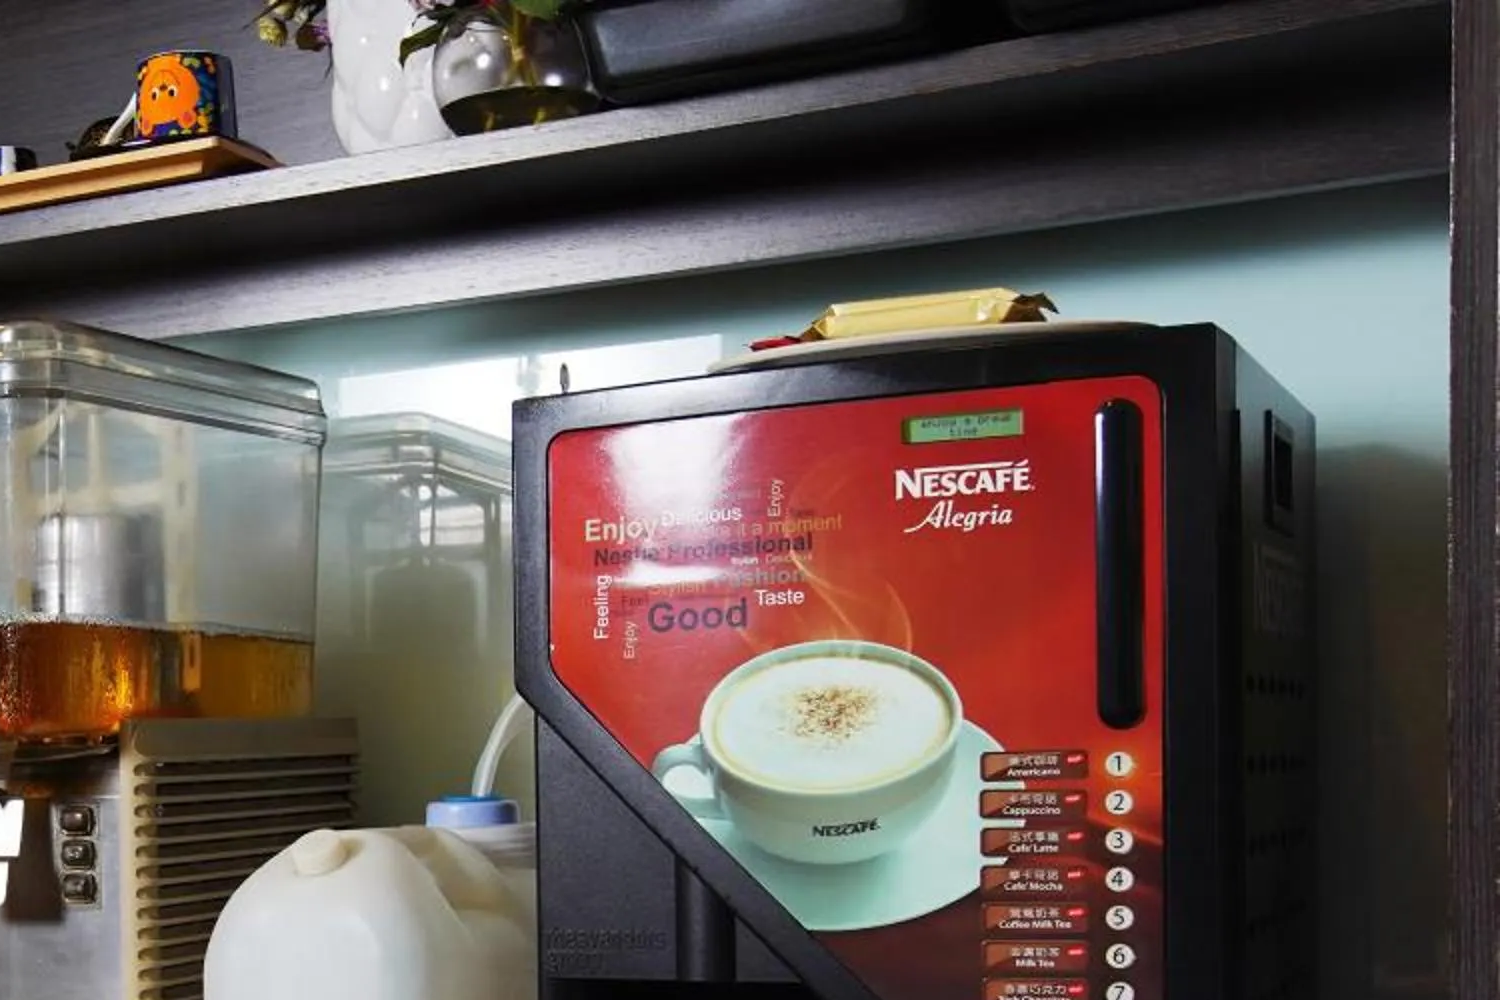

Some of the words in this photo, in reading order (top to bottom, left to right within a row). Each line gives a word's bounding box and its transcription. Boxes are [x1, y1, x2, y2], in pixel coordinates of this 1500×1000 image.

[895, 459, 1031, 500] NESCAFÉ
[768, 479, 785, 518] Enjoy
[584, 515, 660, 545] Enjoy
[769, 514, 843, 534] moment
[904, 500, 1012, 533] Alegria
[594, 575, 613, 640] Feeling
[755, 588, 805, 607] Taste
[648, 598, 748, 633] Good
[624, 620, 640, 659] Enjoy
[1007, 768, 1061, 777] Americano
[1003, 806, 1061, 817] Cappuccino
[1030, 881, 1064, 892] Mocha
[999, 919, 1030, 929] Coffee
[1032, 919, 1054, 929] Milk
[1055, 919, 1072, 929] Tea
